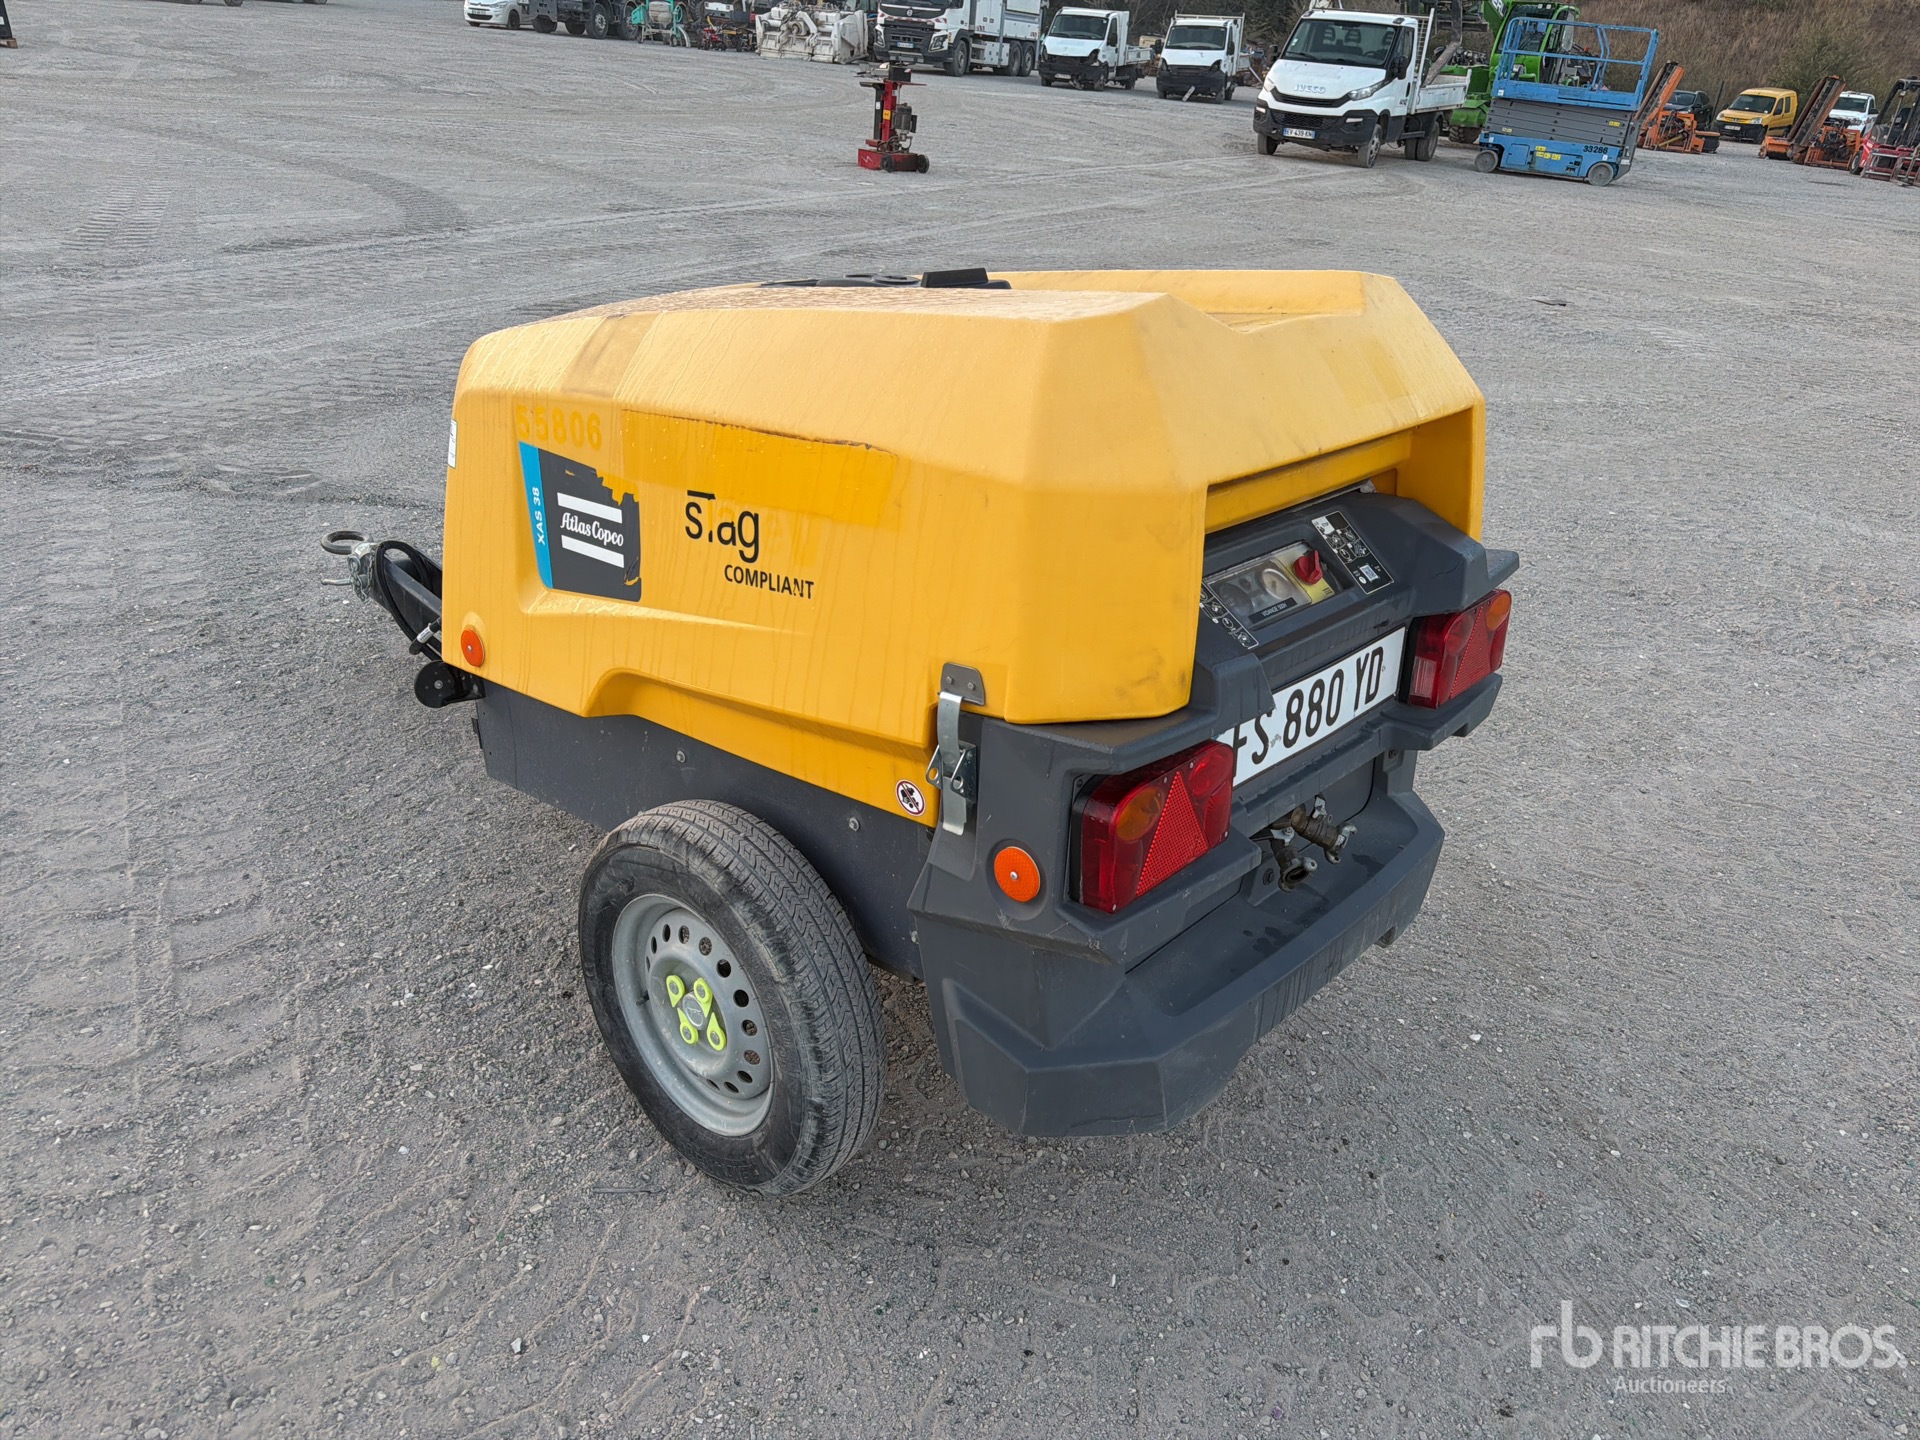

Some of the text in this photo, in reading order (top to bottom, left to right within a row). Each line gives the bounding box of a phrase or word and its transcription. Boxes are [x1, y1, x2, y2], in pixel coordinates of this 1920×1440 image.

[1294, 84, 1326, 94] IVECO
[1583, 145, 1608, 154] 33286
[516, 404, 602, 450] 55806
[532, 486, 545, 546] XAS 38
[724, 564, 814, 599] COMPLIANT
[1283, 668, 1345, 749] 880
[1354, 646, 1384, 712] YD
